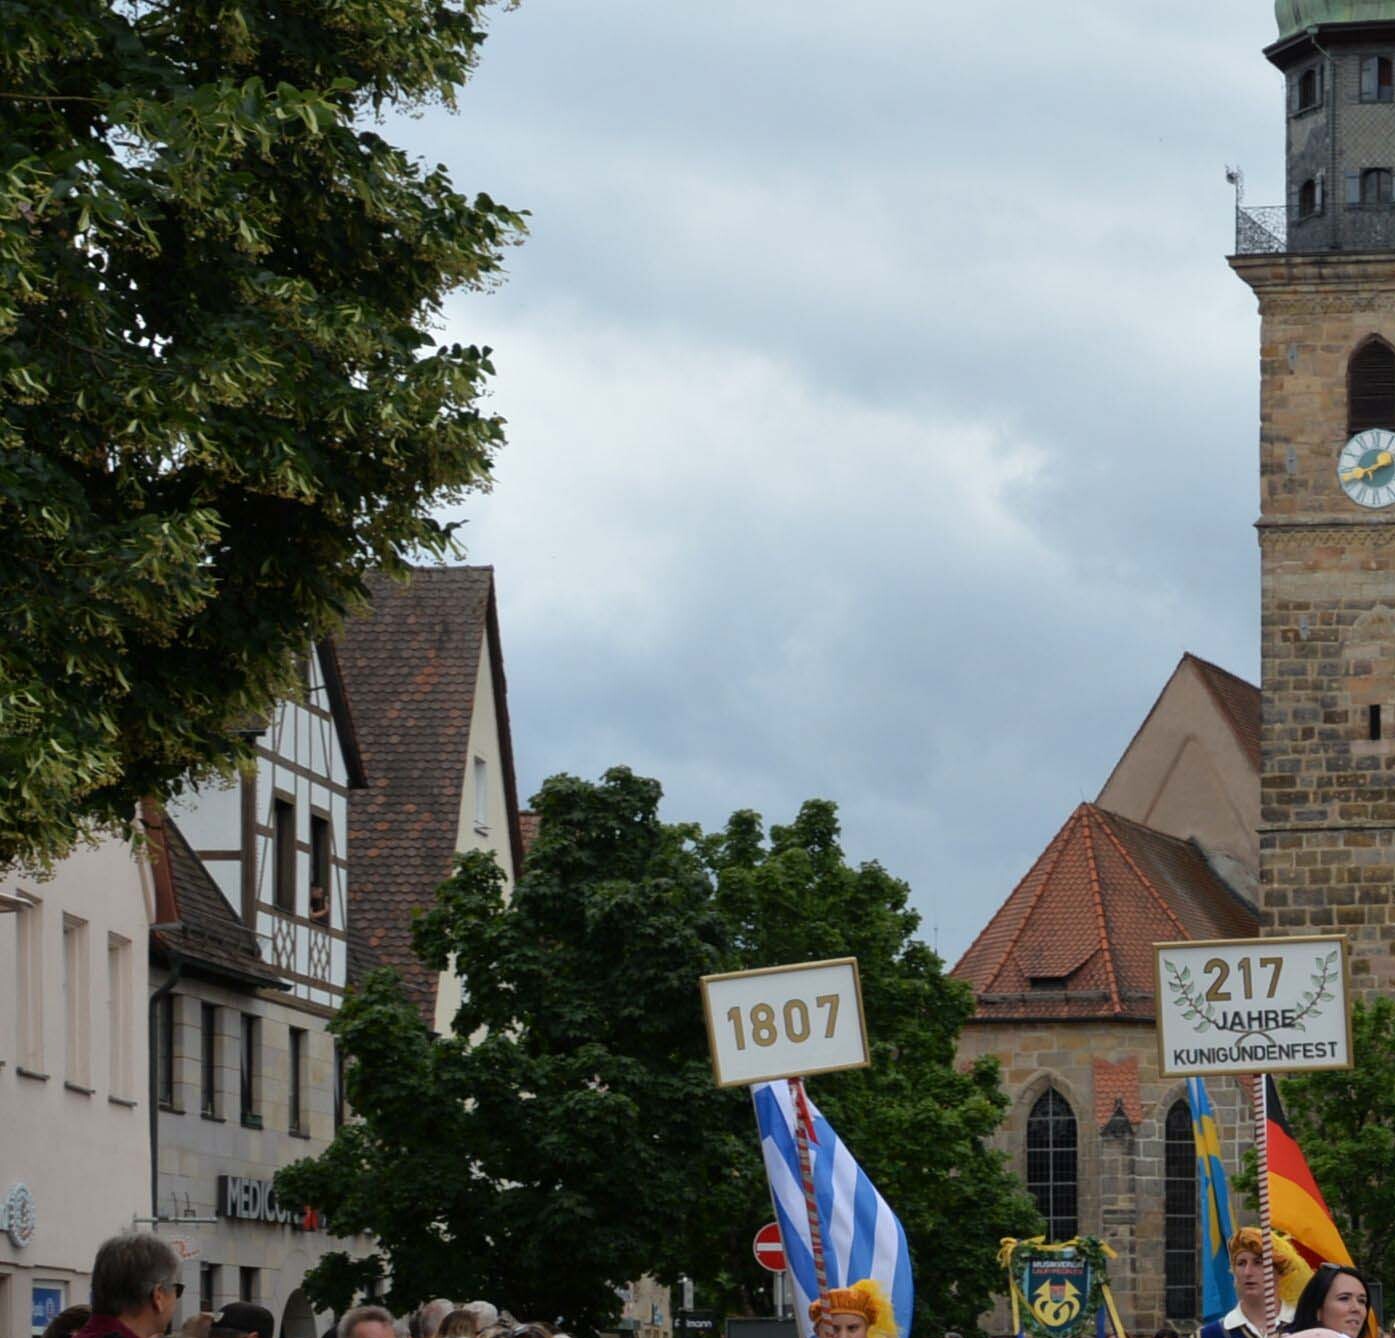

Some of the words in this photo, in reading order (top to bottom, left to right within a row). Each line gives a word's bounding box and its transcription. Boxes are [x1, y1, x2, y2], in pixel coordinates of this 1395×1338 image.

[1203, 956, 1284, 1002] 217
[726, 993, 842, 1051] 1807
[1215, 1009, 1297, 1031] JAHRE
[1173, 1041, 1339, 1066] KUNIGUNDENFEST
